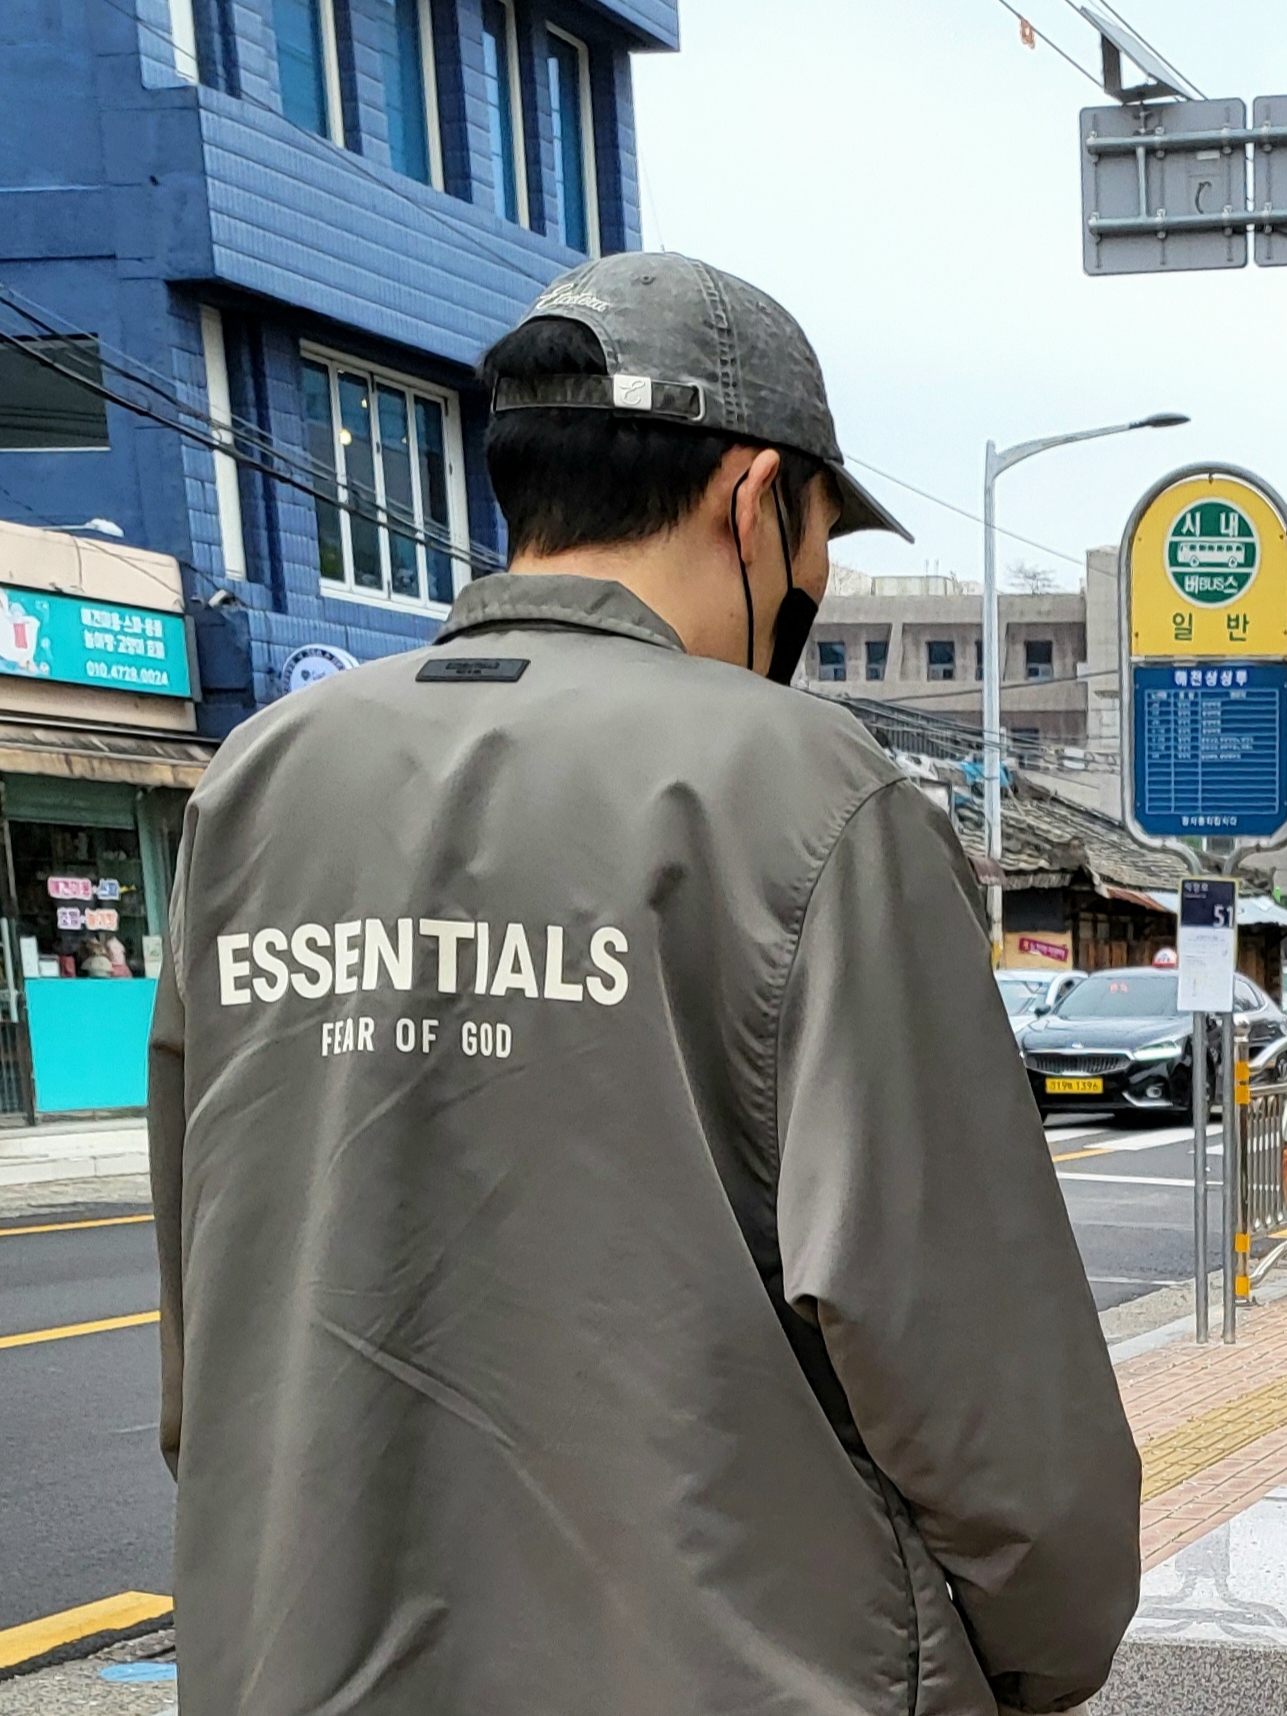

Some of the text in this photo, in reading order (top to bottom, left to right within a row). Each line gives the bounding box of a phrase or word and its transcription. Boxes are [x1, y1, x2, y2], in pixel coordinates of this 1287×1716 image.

[217, 917, 630, 1006] ESSENTIALS
[321, 1016, 512, 1059] FEAR OF GOD
